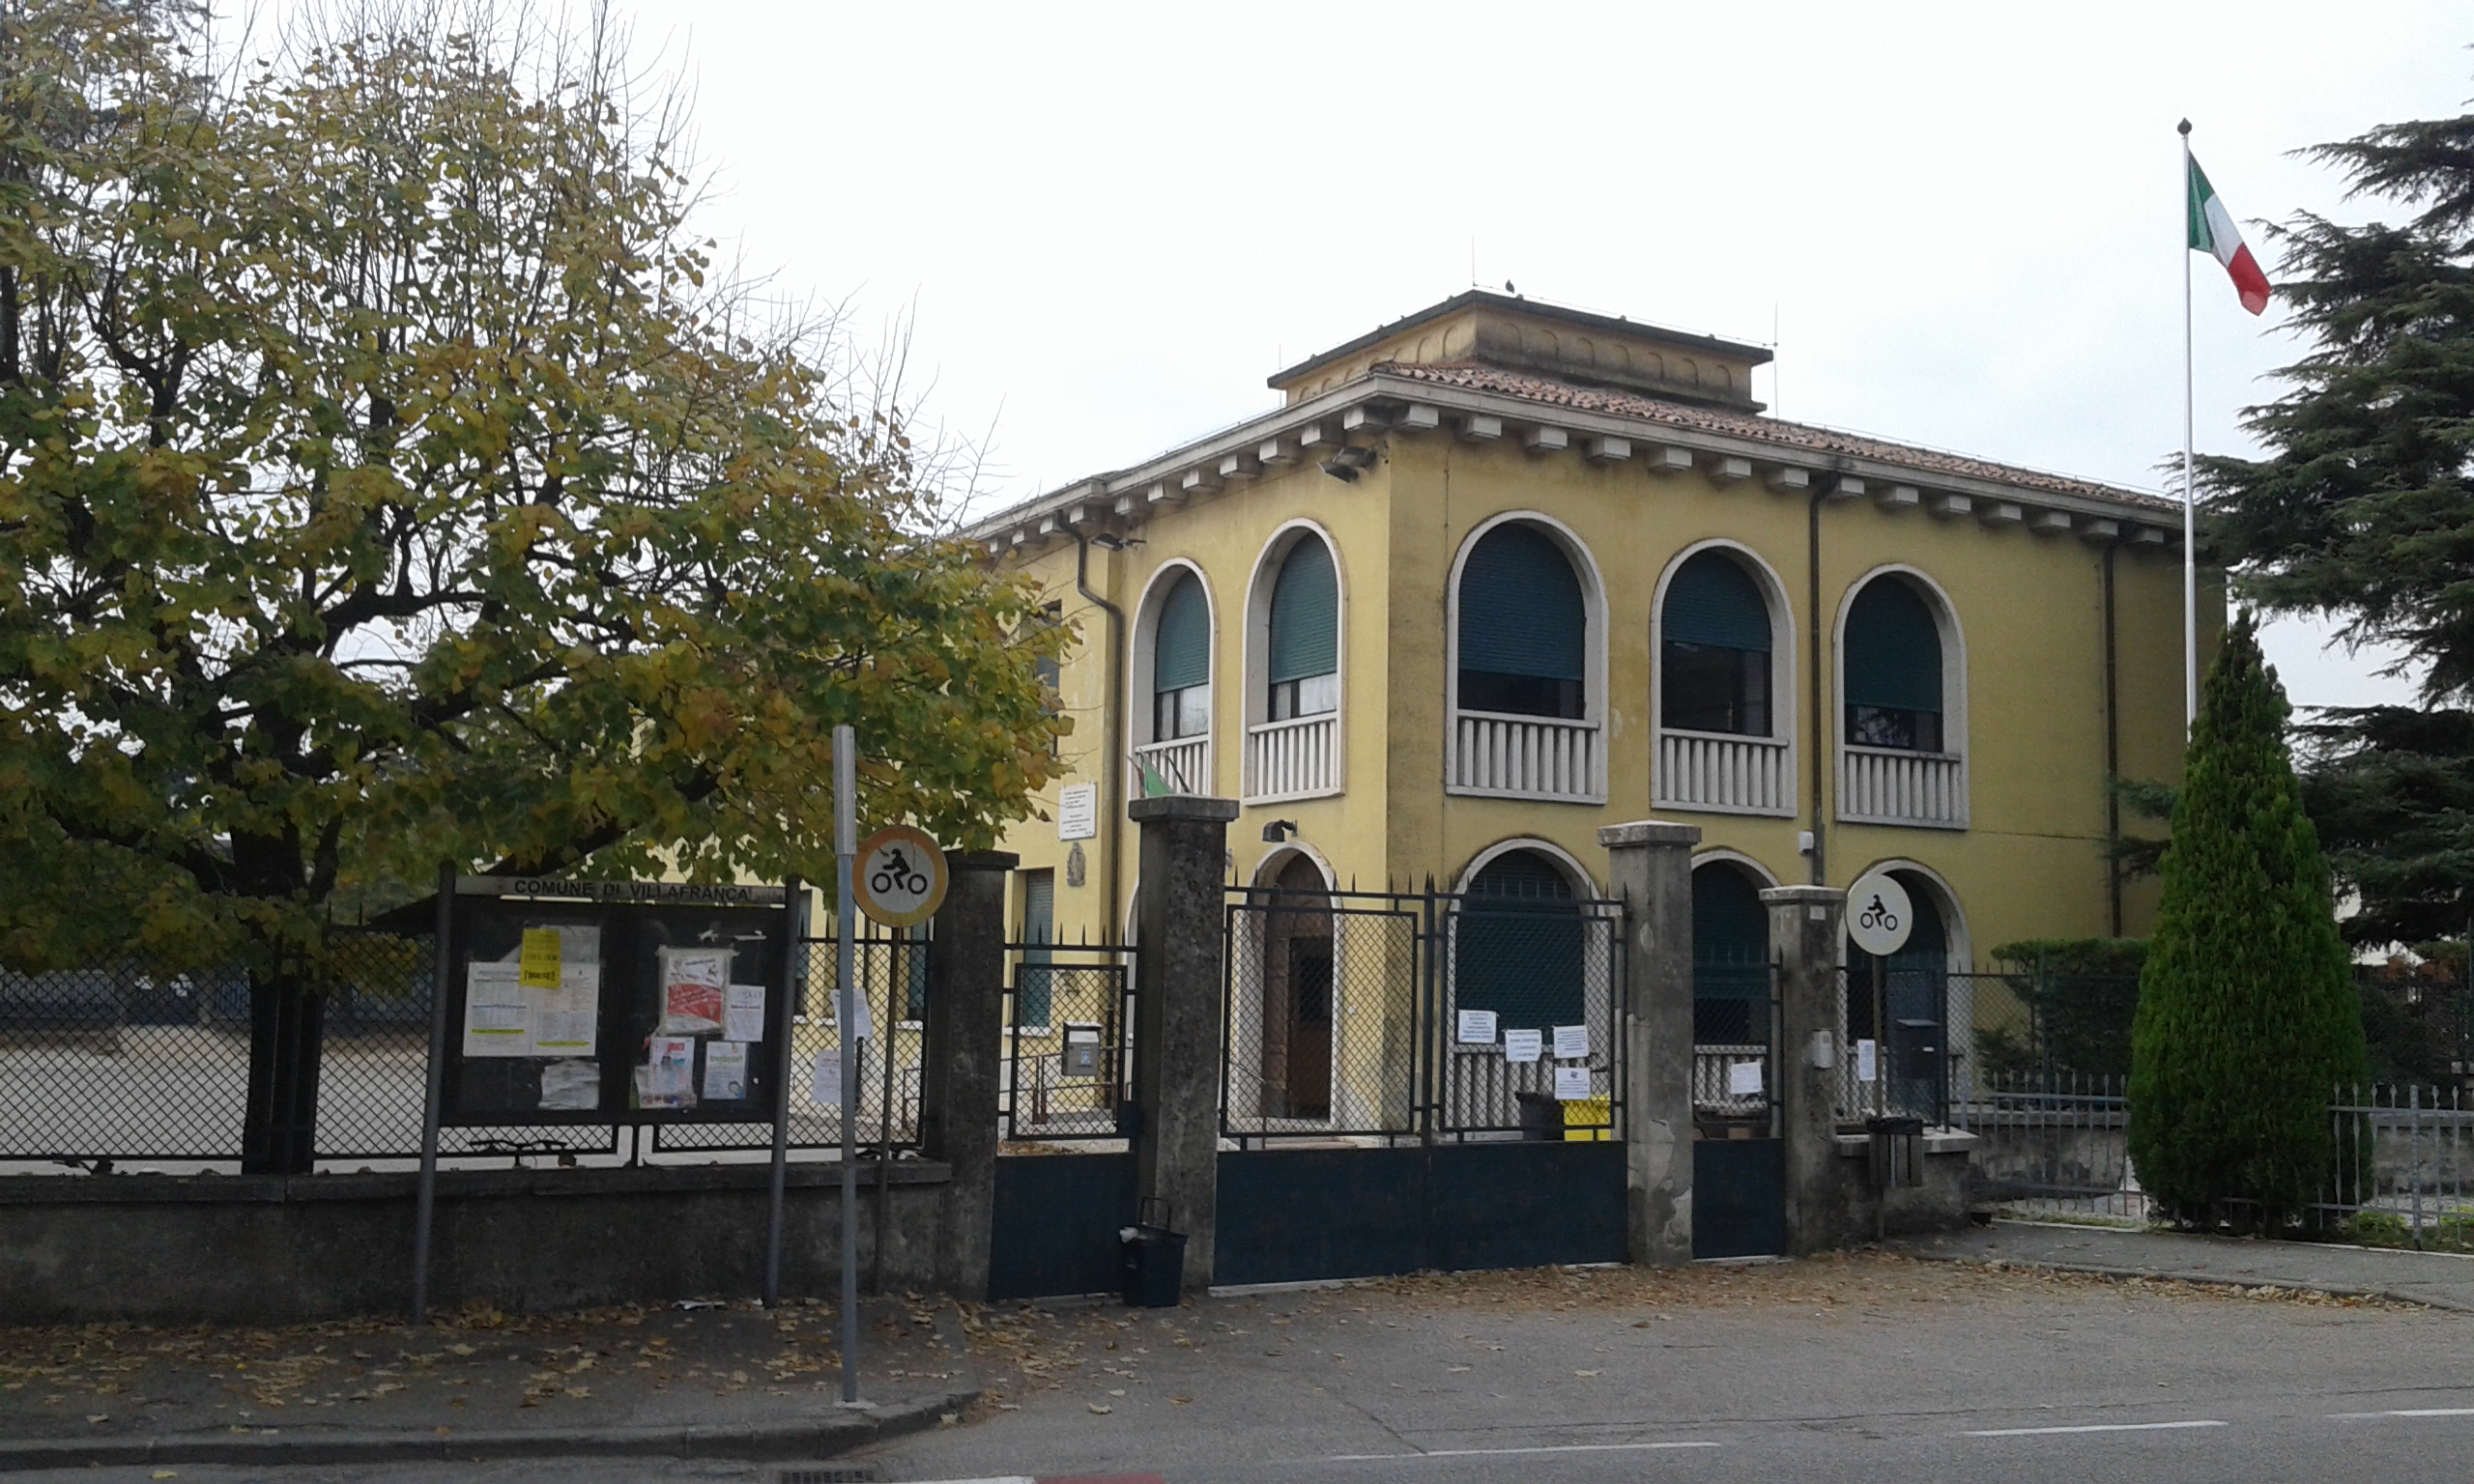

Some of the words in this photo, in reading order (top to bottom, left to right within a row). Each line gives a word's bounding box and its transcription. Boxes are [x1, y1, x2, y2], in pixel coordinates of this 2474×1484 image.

[514, 880, 593, 897] COMUNE
[603, 883, 619, 896] DI
[630, 883, 749, 901] VILLAFRANCA
